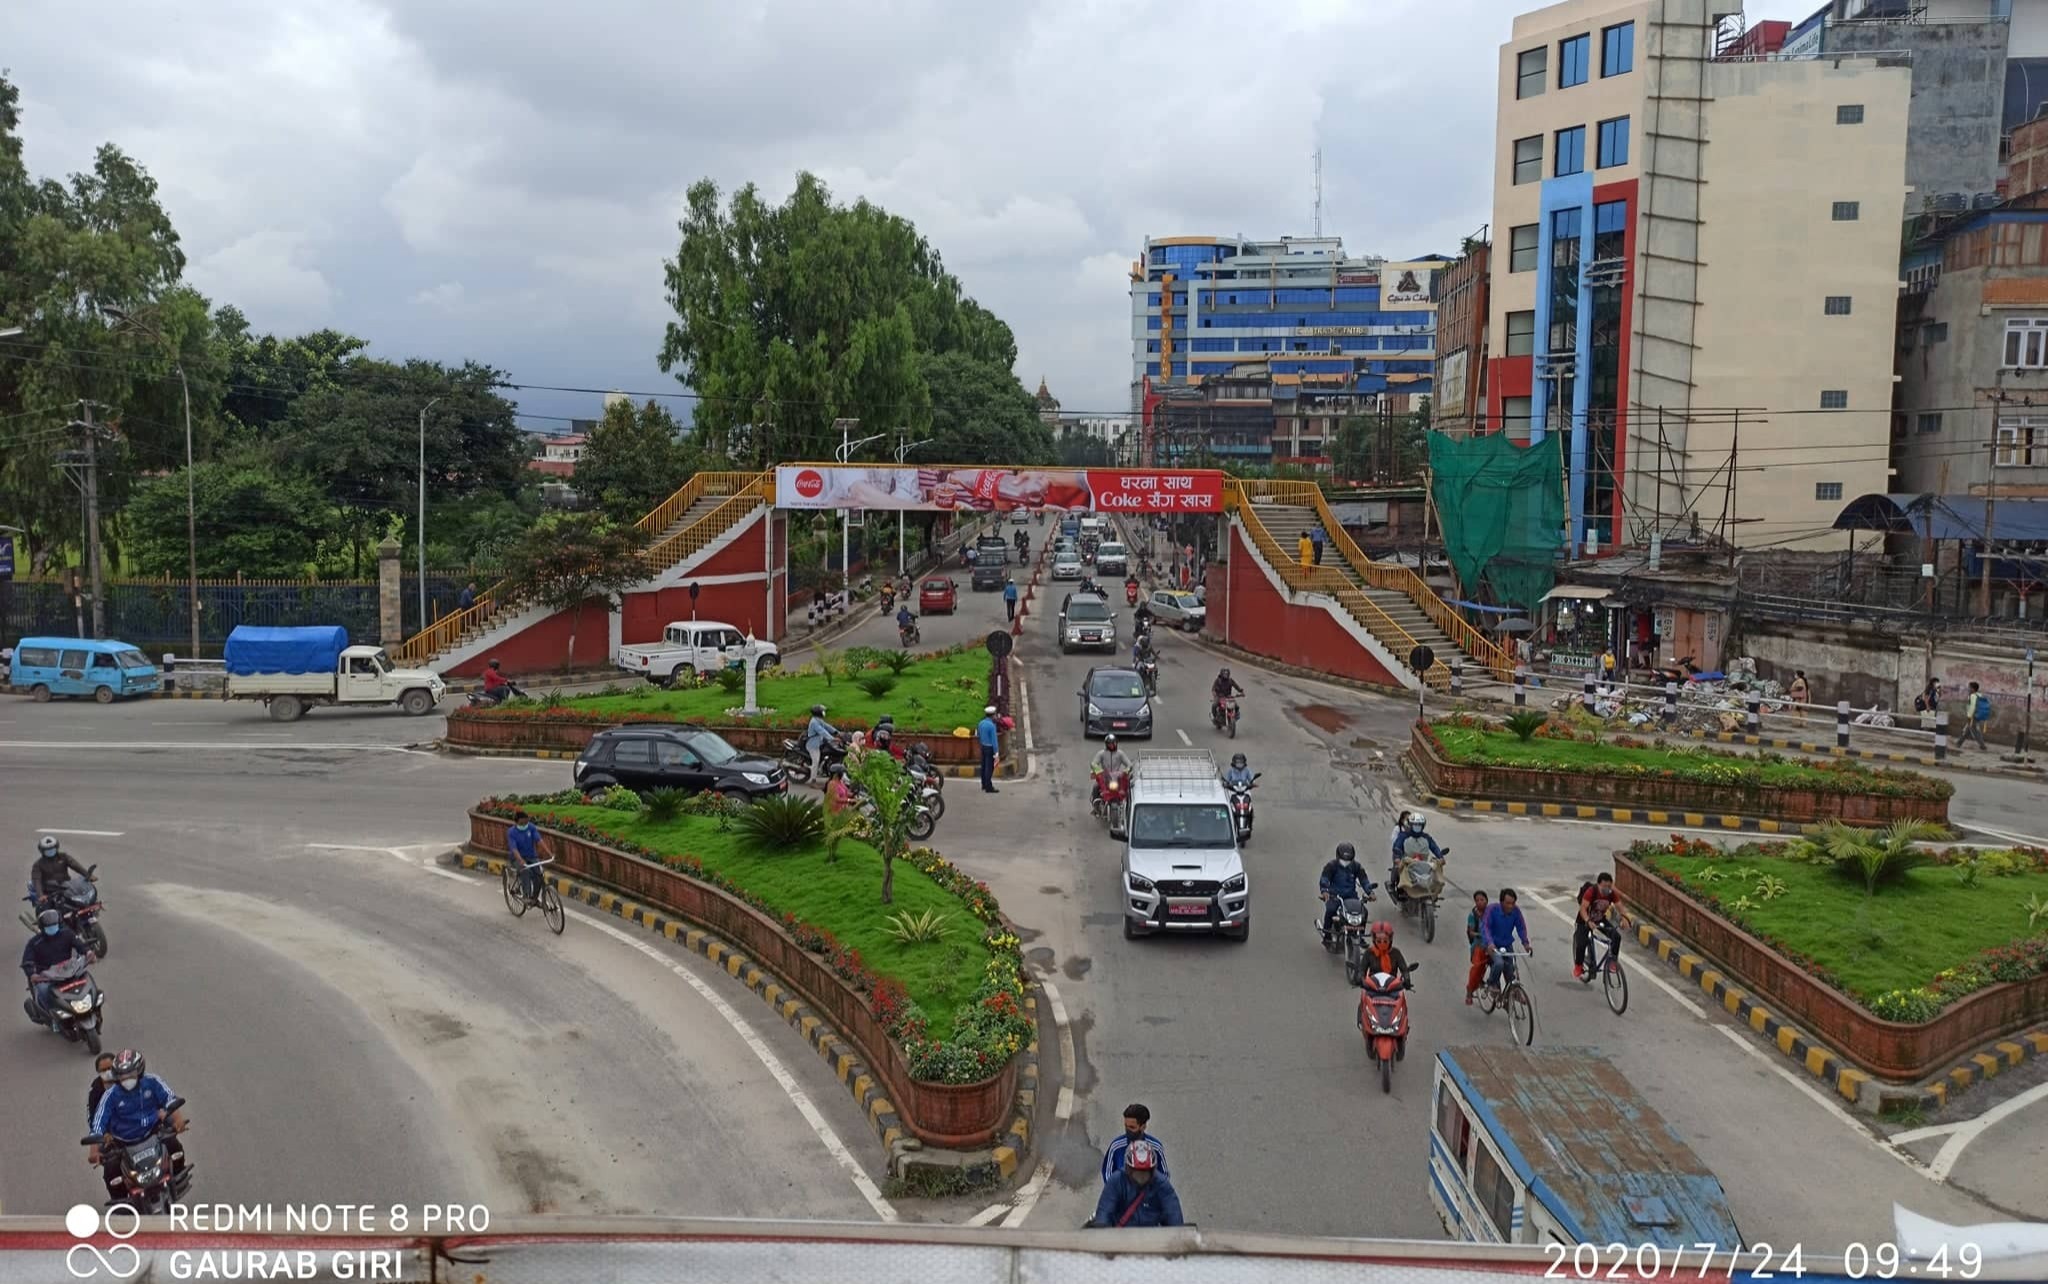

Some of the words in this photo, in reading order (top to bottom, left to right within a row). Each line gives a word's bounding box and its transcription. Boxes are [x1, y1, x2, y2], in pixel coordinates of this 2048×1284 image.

[1120, 476, 1158, 490] घरमा
[1163, 476, 1194, 490] साथ
[1100, 491, 1142, 507] Coke
[1180, 494, 1213, 508] खास
